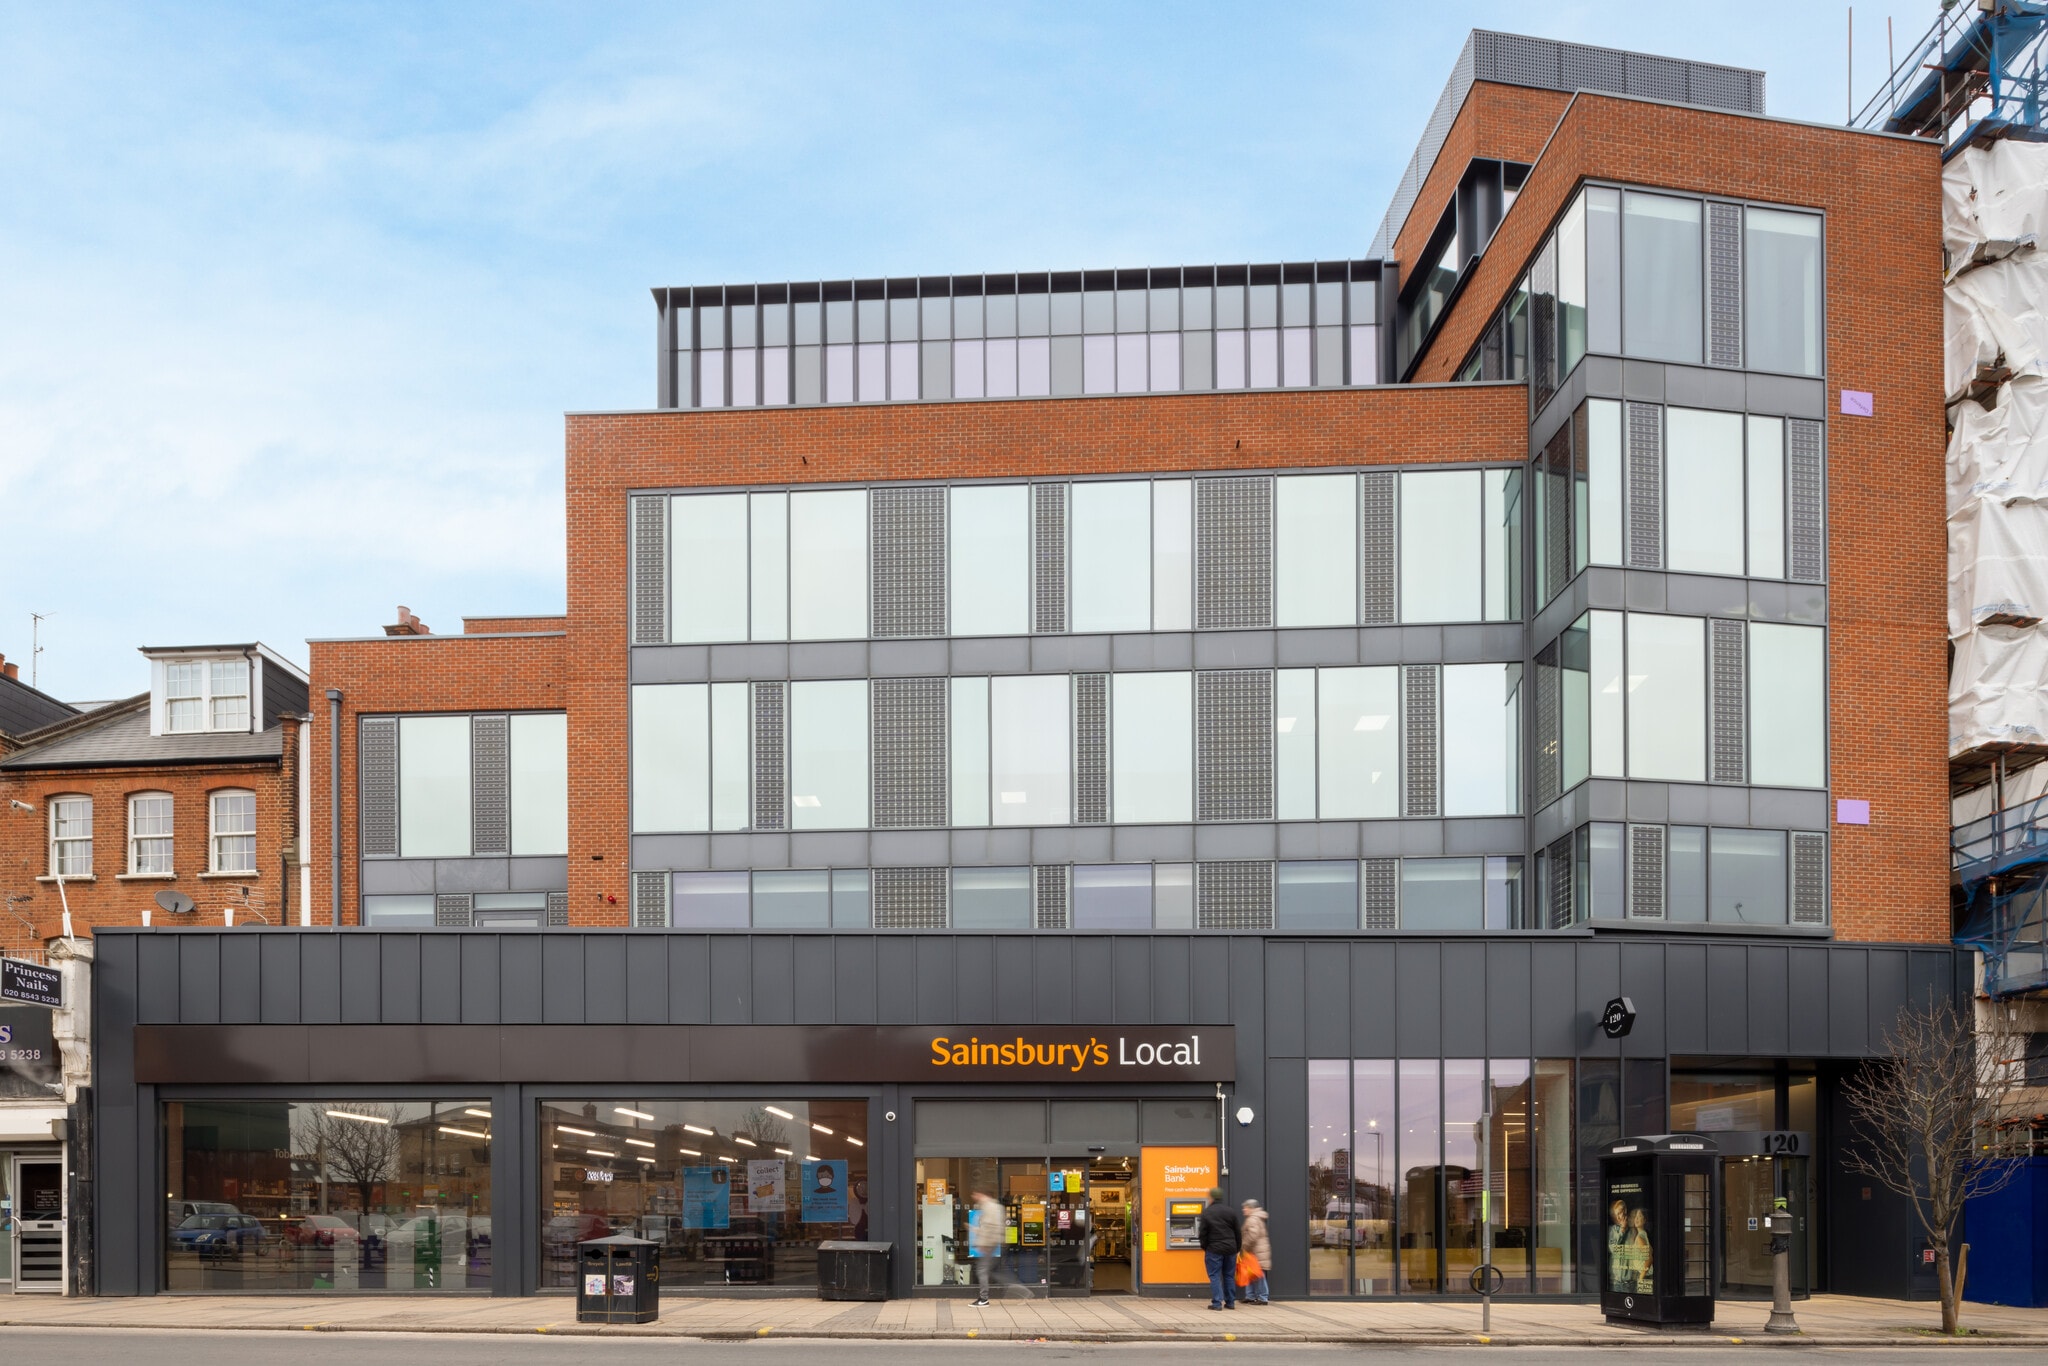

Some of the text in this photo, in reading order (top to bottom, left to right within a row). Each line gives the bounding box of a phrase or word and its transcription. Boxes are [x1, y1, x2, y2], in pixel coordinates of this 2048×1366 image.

[5, 962, 58, 982] Princess
[16, 976, 49, 992] Nails
[4, 988, 60, 1004] 020 8543 5238
[1610, 1012, 1621, 1024] 120
[10, 1050, 41, 1060] 5238
[931, 1036, 1201, 1072] Sainsbury's Local
[1762, 1134, 1799, 1153] 120
[273, 1148, 309, 1161] Tobacco
[756, 1166, 779, 1175] collect
[1164, 1165, 1210, 1175] Sainsbury's
[1165, 1174, 1186, 1183] Bank
